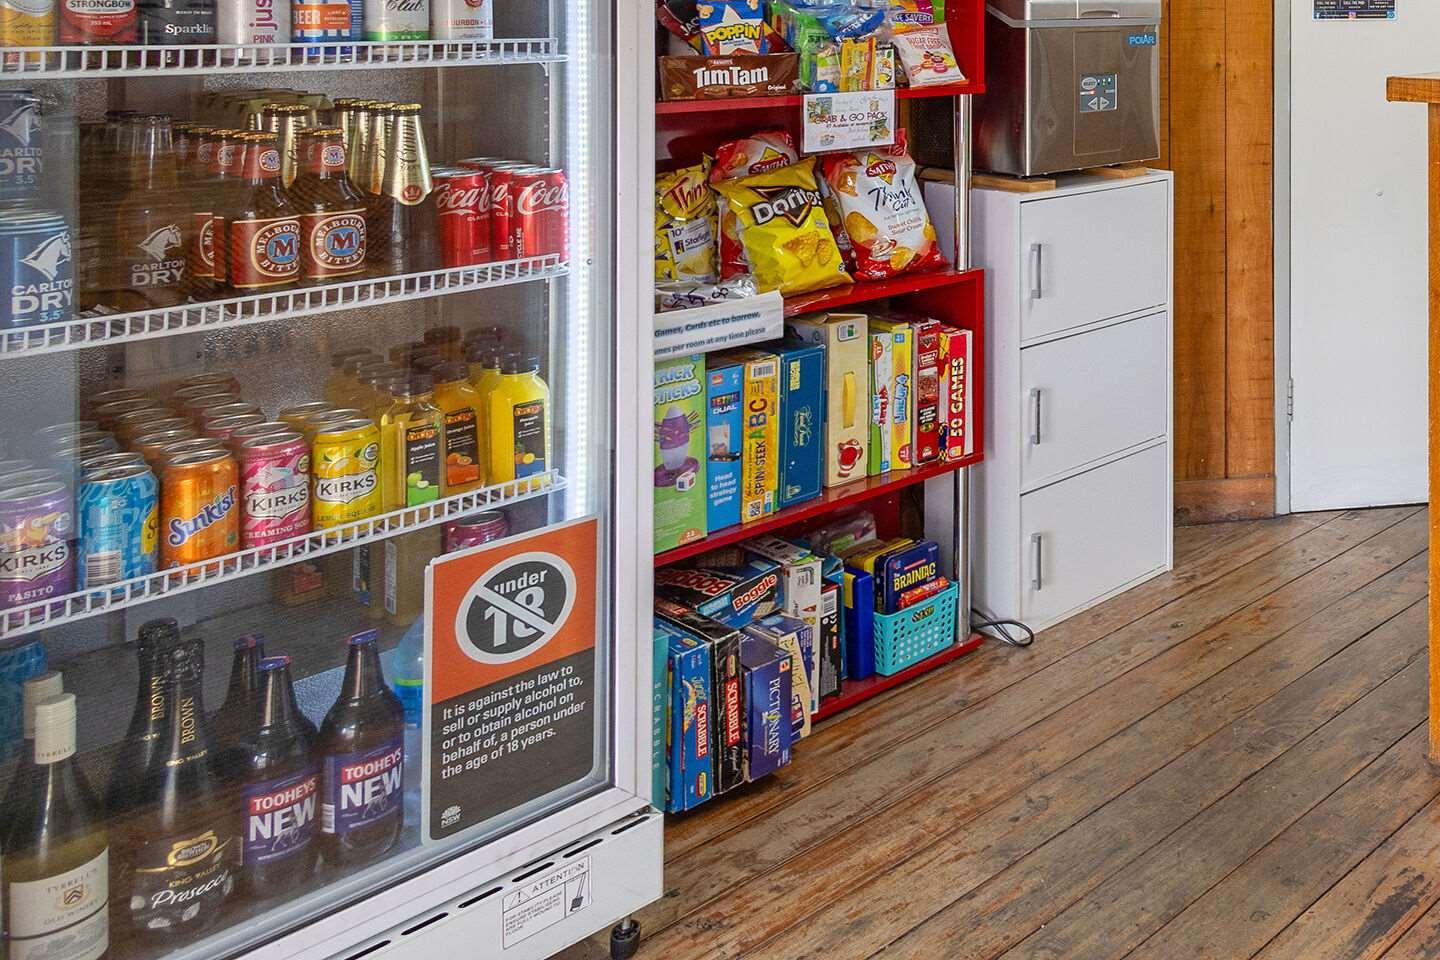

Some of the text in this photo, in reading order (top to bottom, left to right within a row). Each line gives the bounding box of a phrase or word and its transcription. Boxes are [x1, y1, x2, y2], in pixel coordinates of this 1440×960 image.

[70, 0, 133, 9] STRONGBOW
[293, 9, 321, 26] BEER
[706, 23, 762, 45] POPPIN
[1129, 34, 1156, 45] POLAR
[849, 113, 864, 121] GO
[752, 188, 822, 224] Doritos
[274, 238, 295, 258] M
[319, 247, 364, 264] BITTER
[331, 232, 355, 249] M
[132, 259, 186, 272] CARLTON
[132, 268, 185, 286] DRY
[11, 290, 72, 315] DRY
[672, 344, 684, 352] per
[686, 339, 705, 349] room
[729, 331, 744, 339] time
[745, 327, 766, 336] please
[685, 321, 707, 331] Cards
[708, 319, 720, 327] etc
[713, 405, 737, 415] DUAL
[950, 357, 964, 437] 50 GAMES
[749, 398, 768, 440] ABC
[756, 440, 766, 466] SEEK
[320, 474, 376, 496] KIRKS
[714, 472, 733, 482] Head
[252, 487, 307, 513] KIRKS
[168, 485, 237, 548] Sunkist
[0, 546, 66, 573] KIRKS
[893, 562, 936, 592] BRAINIAC
[8, 585, 54, 601] PASITO
[732, 574, 778, 612] Boggle
[484, 586, 546, 648] 18
[151, 675, 165, 722] BROWN
[443, 665, 573, 720] It is against the law to
[443, 719, 464, 735] sell
[467, 714, 481, 726] or
[483, 698, 523, 721] supply
[525, 679, 567, 704] alcohol
[182, 698, 197, 745] BROWN
[442, 693, 574, 750] or to obtain alcohol on
[727, 681, 741, 744] SCRABBLE
[442, 743, 481, 766] behalf
[500, 731, 508, 741] a
[511, 716, 551, 742] person
[553, 701, 586, 721] under
[696, 703, 708, 758] SCRABBLE
[345, 747, 402, 781] TOOHEYS
[441, 727, 557, 780] the age of 18 years.
[253, 777, 316, 811] TOOHEYS
[340, 761, 401, 811] NEW
[250, 791, 317, 843] NEW
[151, 869, 229, 909] Prosecco
[532, 862, 585, 893] ATTENTION
